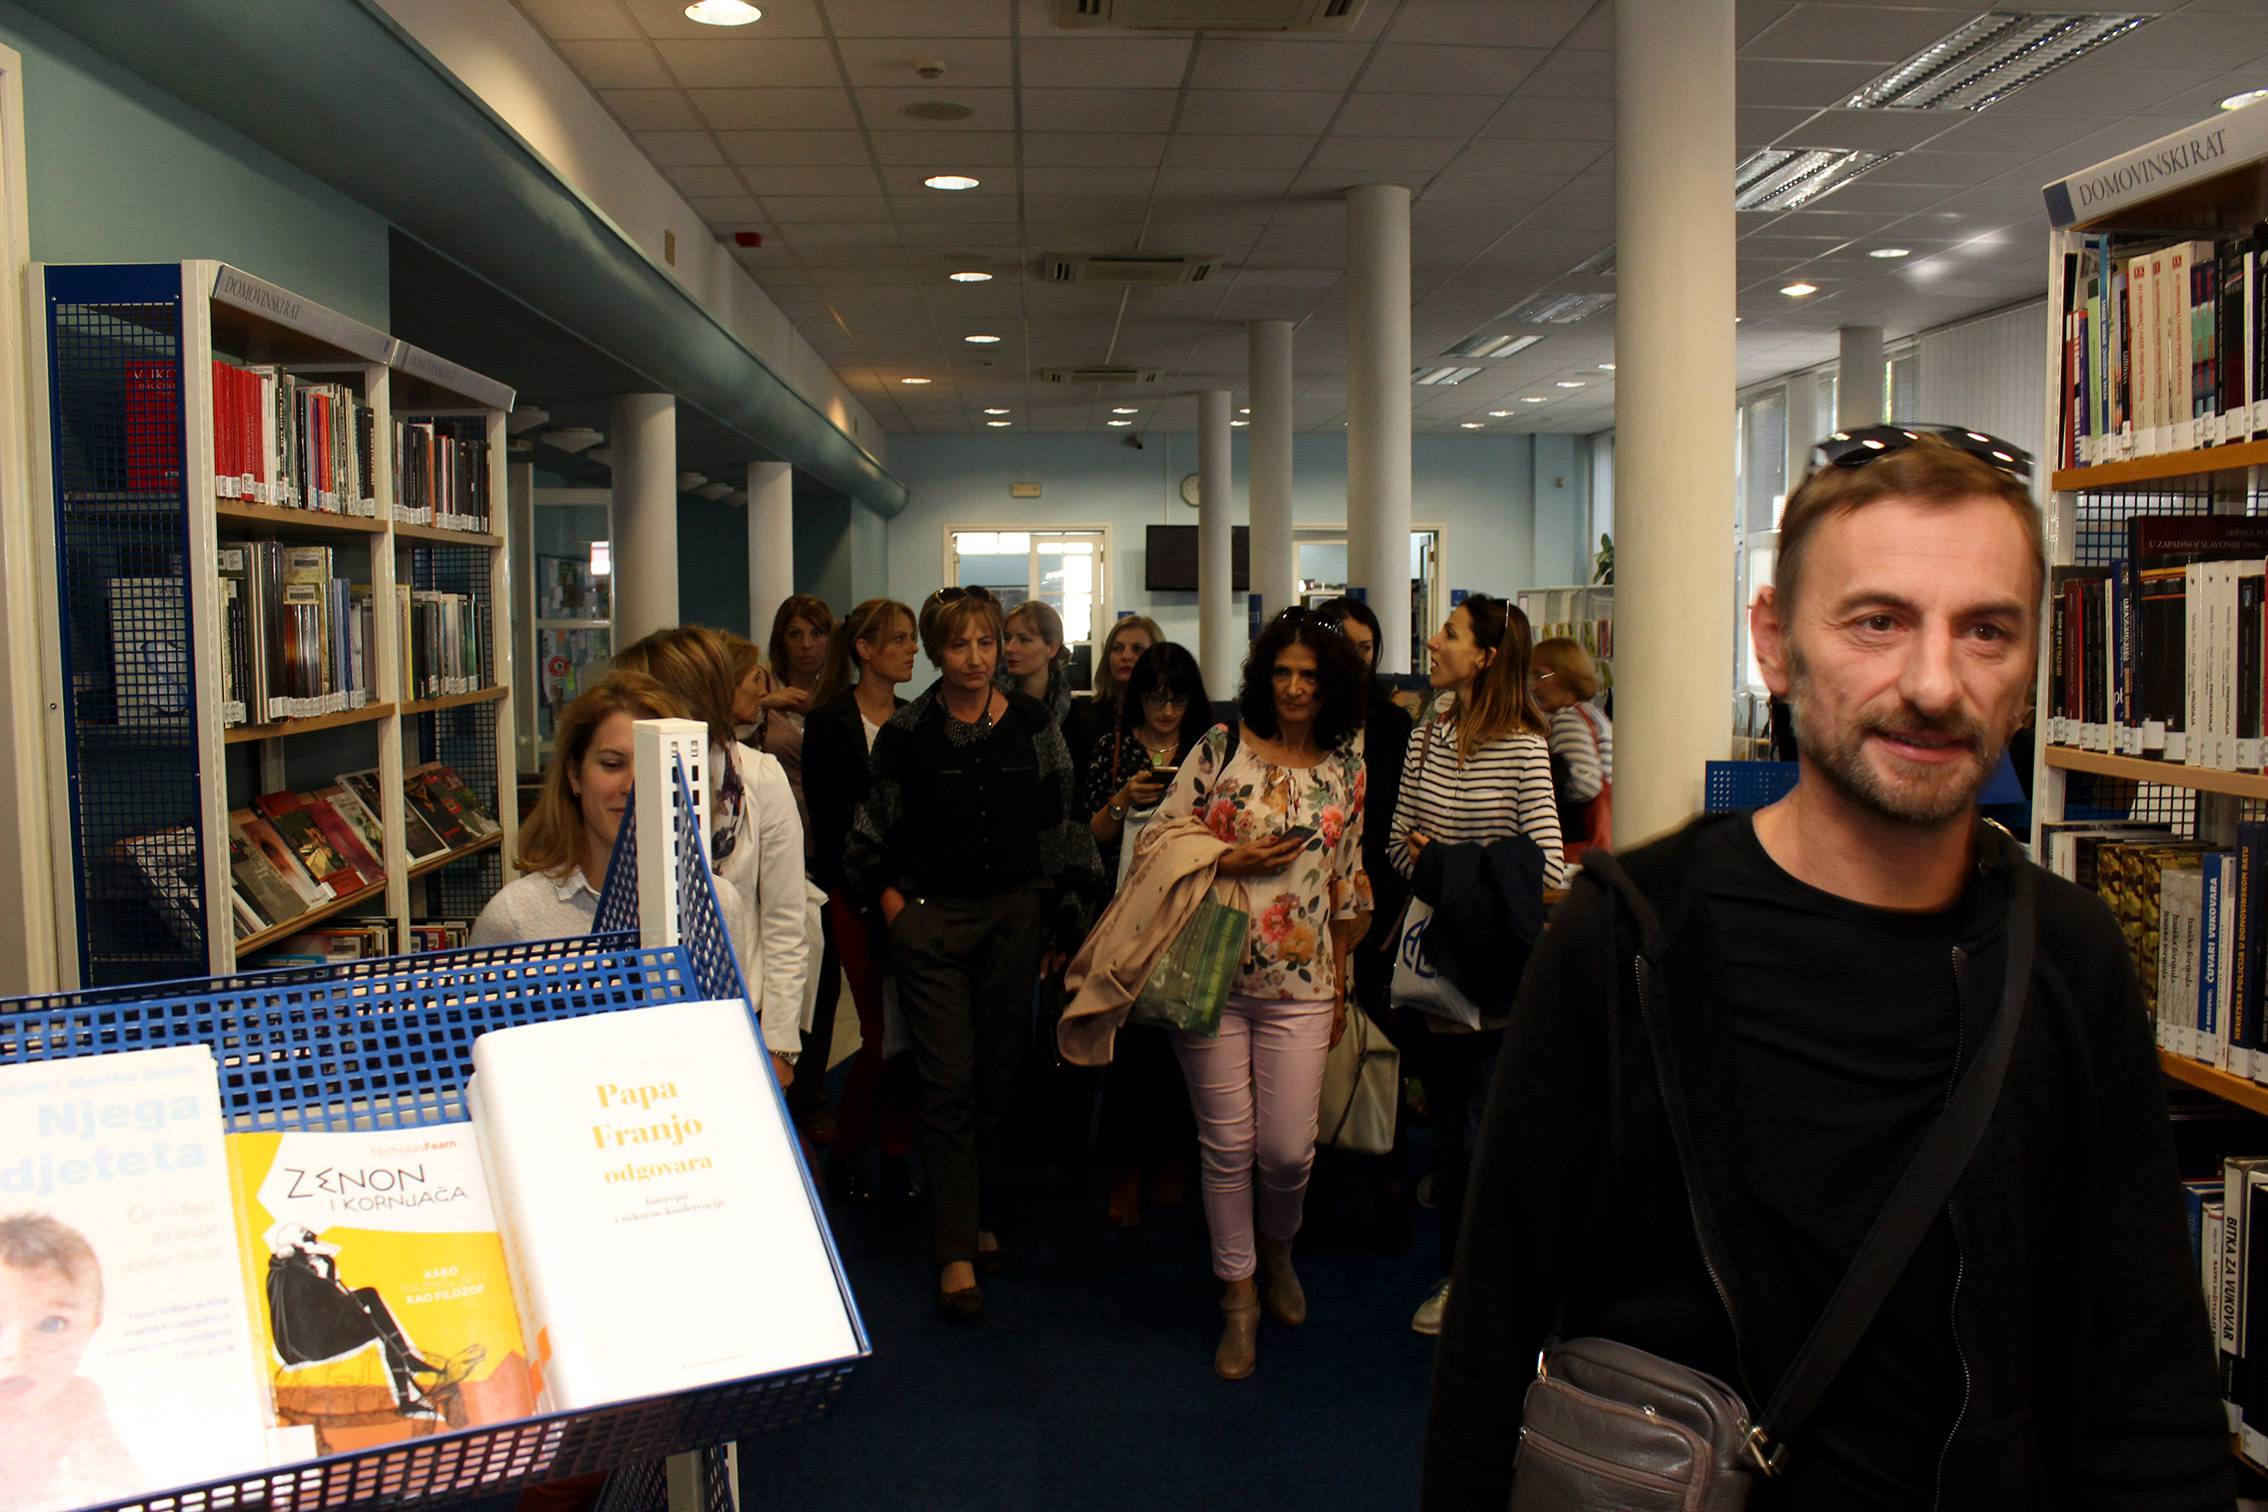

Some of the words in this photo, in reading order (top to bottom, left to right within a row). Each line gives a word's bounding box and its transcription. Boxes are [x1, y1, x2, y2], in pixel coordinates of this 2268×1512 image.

[2079, 143, 2190, 207] DOMOVINSKI
[2190, 127, 2227, 166] RAT
[224, 275, 284, 314] DOMOVINSKI
[283, 300, 302, 320] RAT
[2242, 846, 2250, 871] RATU
[2208, 877, 2218, 939] VUKOVARA
[2239, 872, 2249, 941] DOMOVINSKOM
[2236, 951, 2246, 992] POLICIJA
[2234, 993, 2244, 1040] HRVATSKA
[595, 1080, 678, 1111] Papa
[36, 1093, 201, 1141] Njega
[591, 1114, 704, 1150] Franjo
[0, 1141, 207, 1197] djeteta
[284, 1164, 426, 1199] ZENON
[602, 1154, 714, 1185] odgovara
[343, 1185, 469, 1213] KORNJAČA
[2225, 1215, 2237, 1254] BITKA
[2225, 1257, 2236, 1275] ZA
[2223, 1280, 2236, 1342] VUKOVAR
